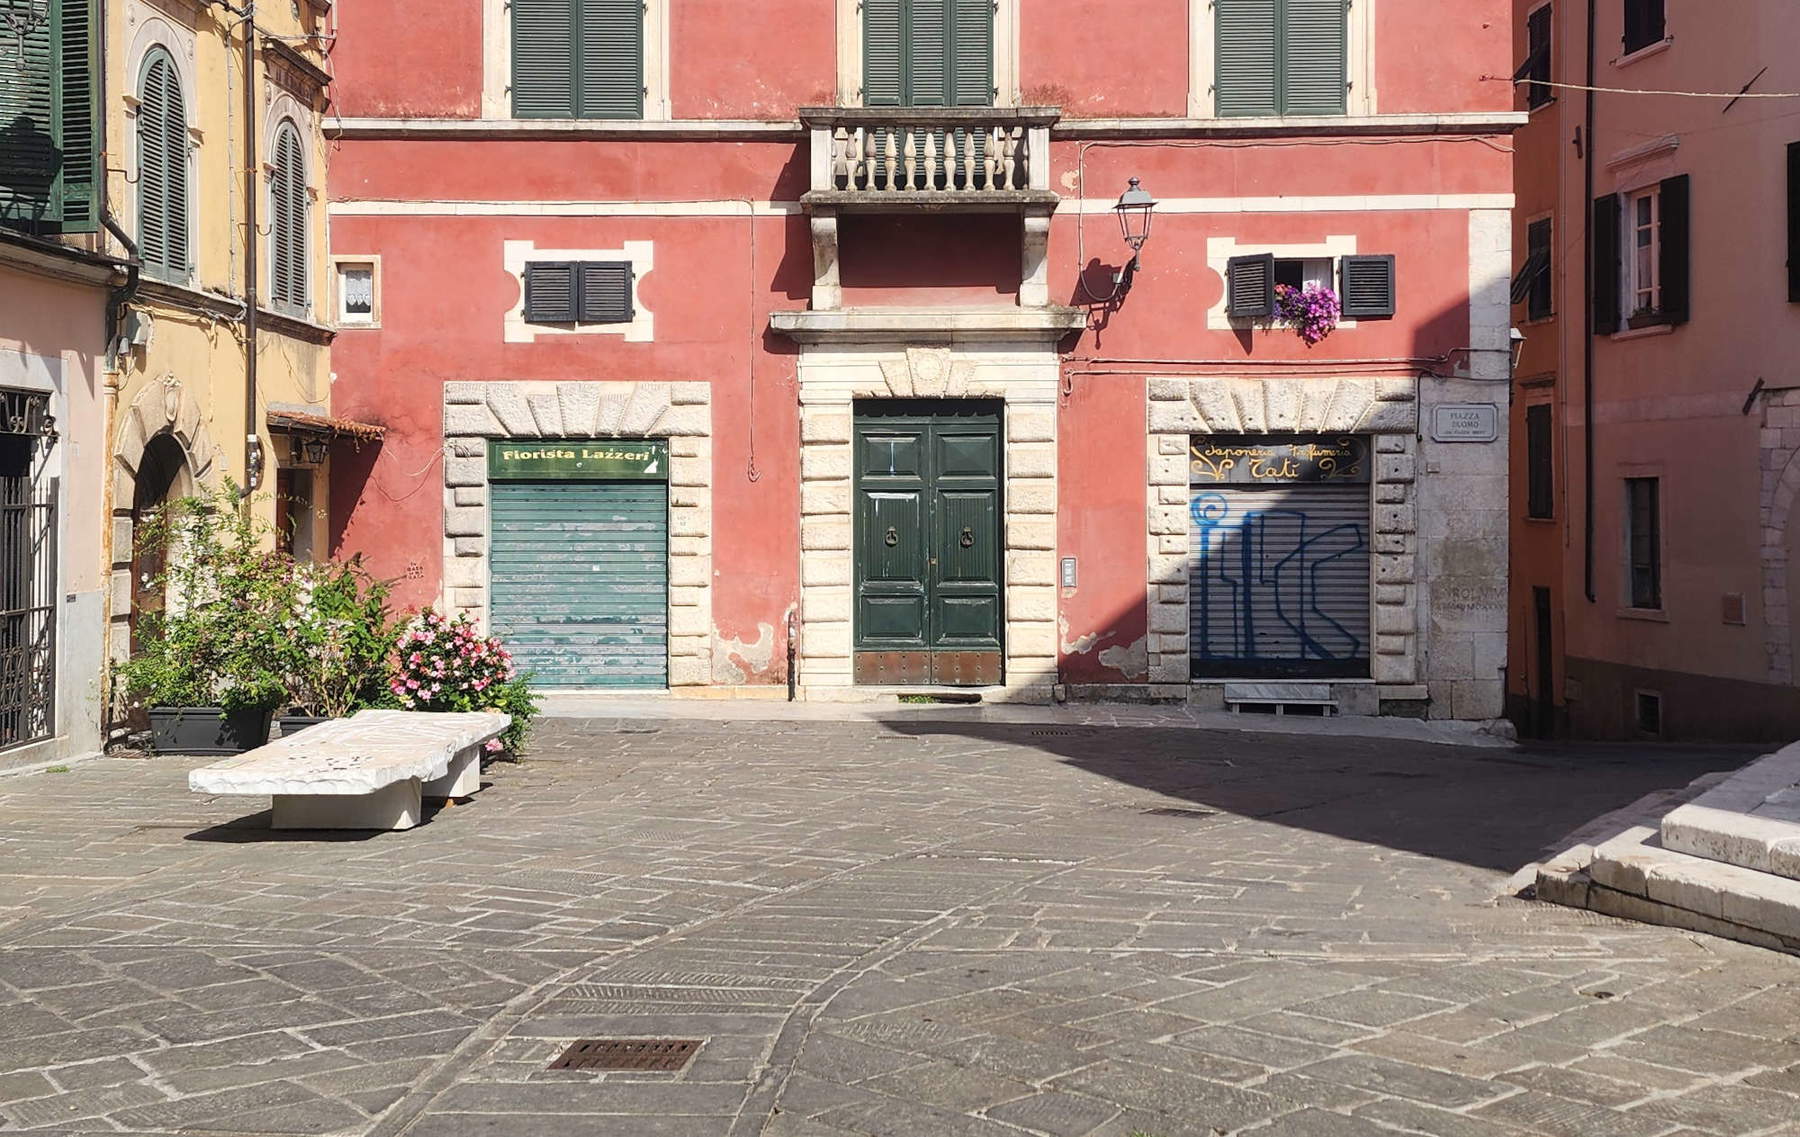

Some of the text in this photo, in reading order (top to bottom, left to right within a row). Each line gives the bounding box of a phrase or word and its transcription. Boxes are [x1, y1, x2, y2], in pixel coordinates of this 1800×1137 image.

[1450, 412, 1480, 420] PIAZZA
[502, 447, 650, 461] Fiorista Lazzeri
